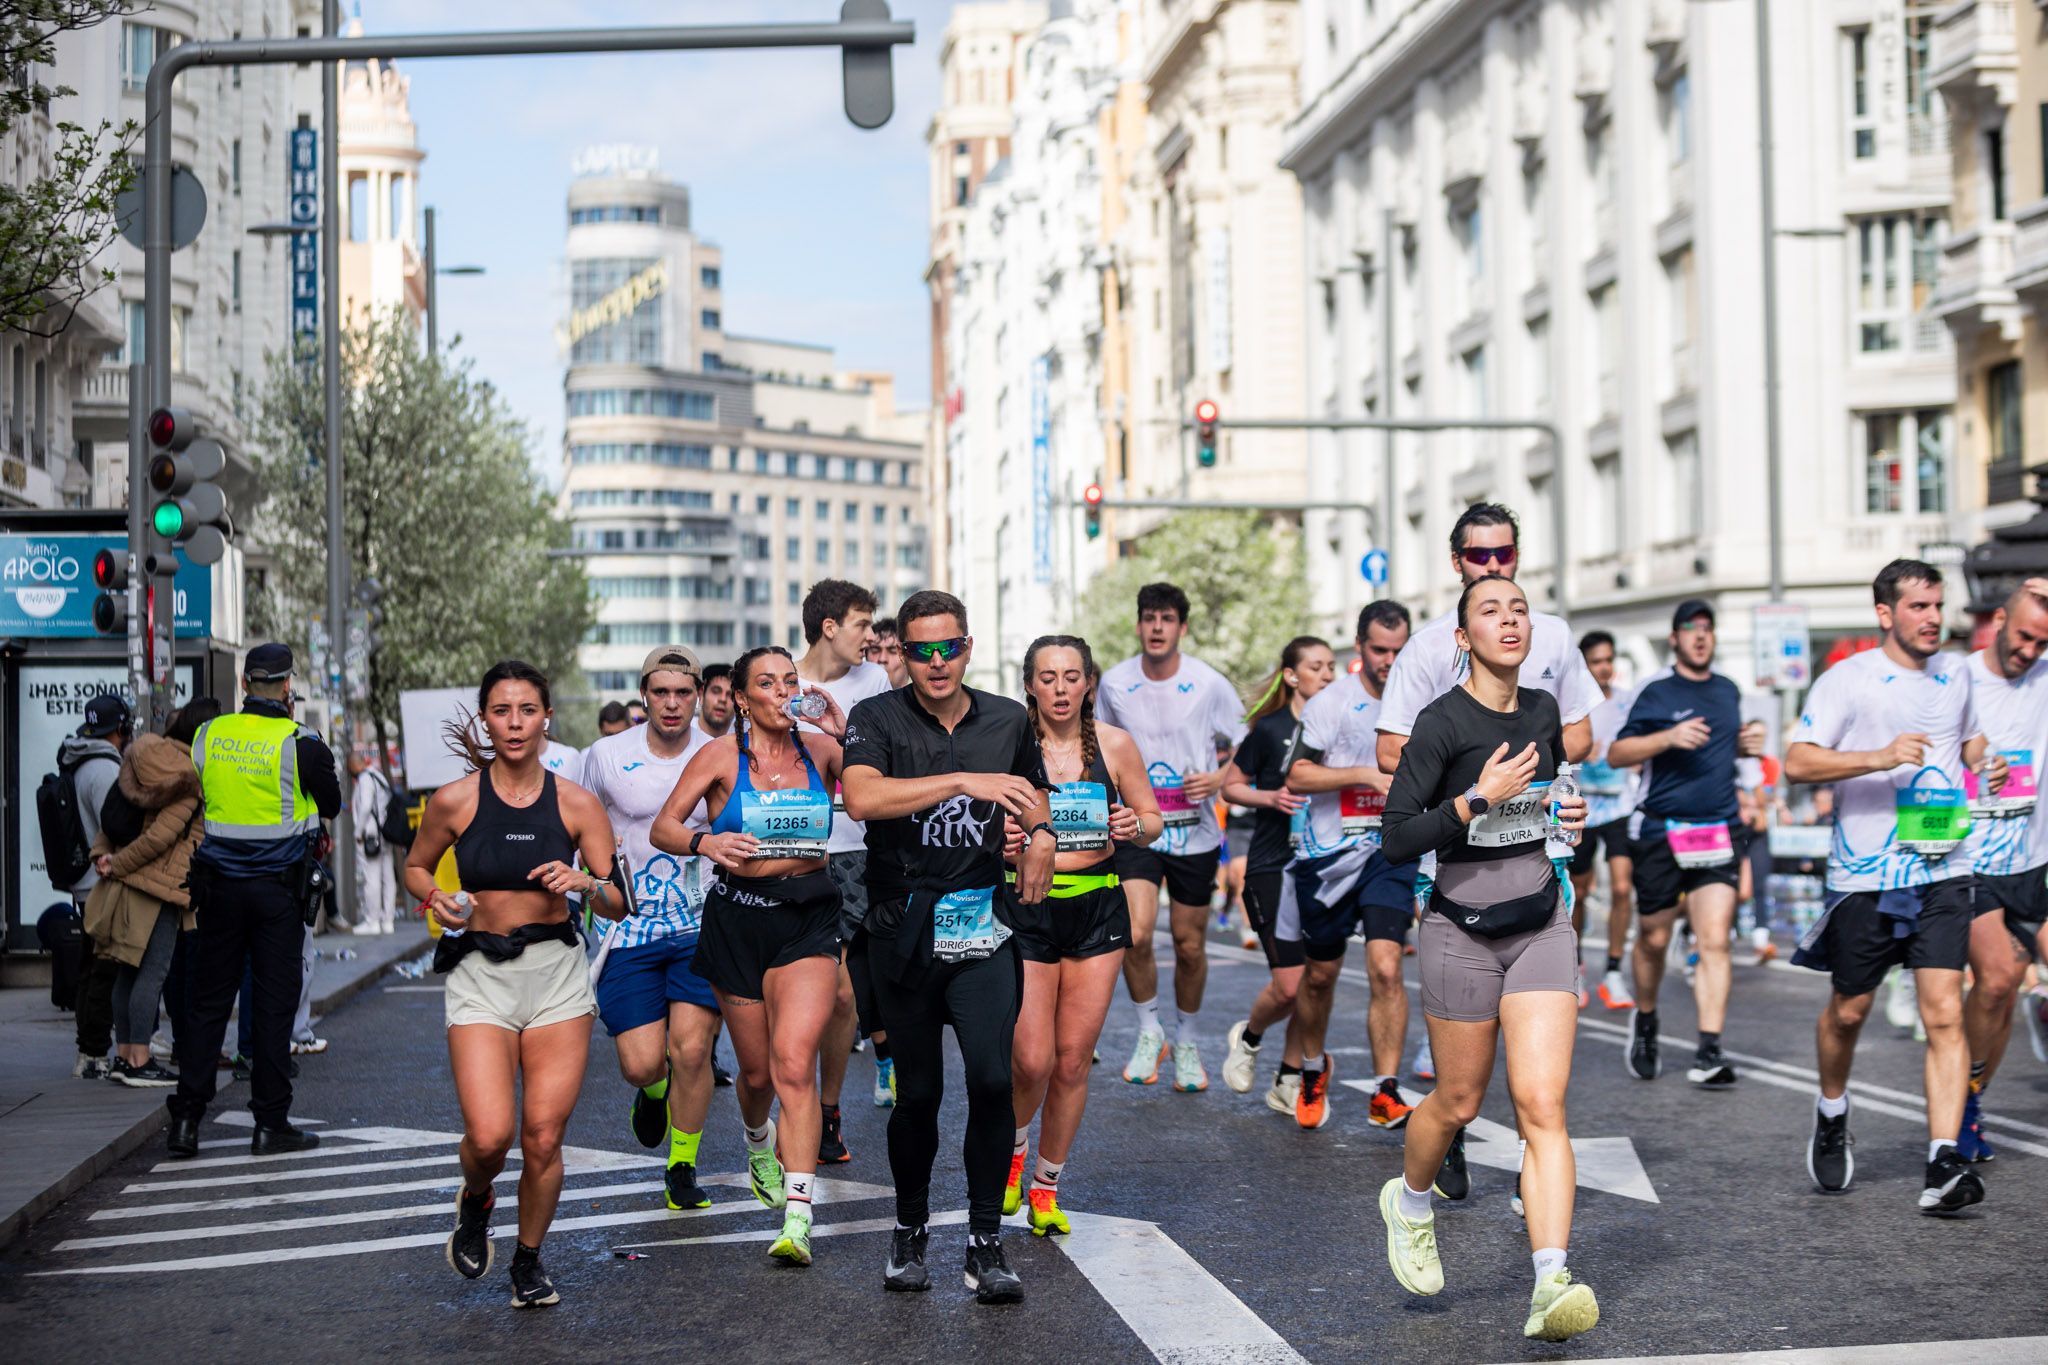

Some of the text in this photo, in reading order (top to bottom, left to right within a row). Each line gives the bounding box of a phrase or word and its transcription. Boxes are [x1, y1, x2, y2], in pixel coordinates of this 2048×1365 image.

[293, 169, 318, 299] HOTEL
[3, 556, 80, 581] APOLO
[29, 679, 129, 698] ¿HAS SOÑAD
[46, 701, 83, 715] ESTE
[211, 737, 276, 756] POLICÍA
[211, 753, 272, 767] MUNICIPAL
[237, 765, 272, 777] Madrid
[781, 793, 812, 801] Movistar
[1052, 809, 1088, 822] 2364
[1498, 800, 1537, 818] 15881
[765, 817, 809, 830] 12365
[506, 833, 535, 841] OYSHO
[922, 822, 984, 847] RUN
[1499, 829, 1533, 843] ELVIRA
[690, 887, 702, 903] 412
[949, 893, 983, 902] Movistar
[935, 914, 973, 928] 2517
[934, 940, 973, 949] ODRIGO
